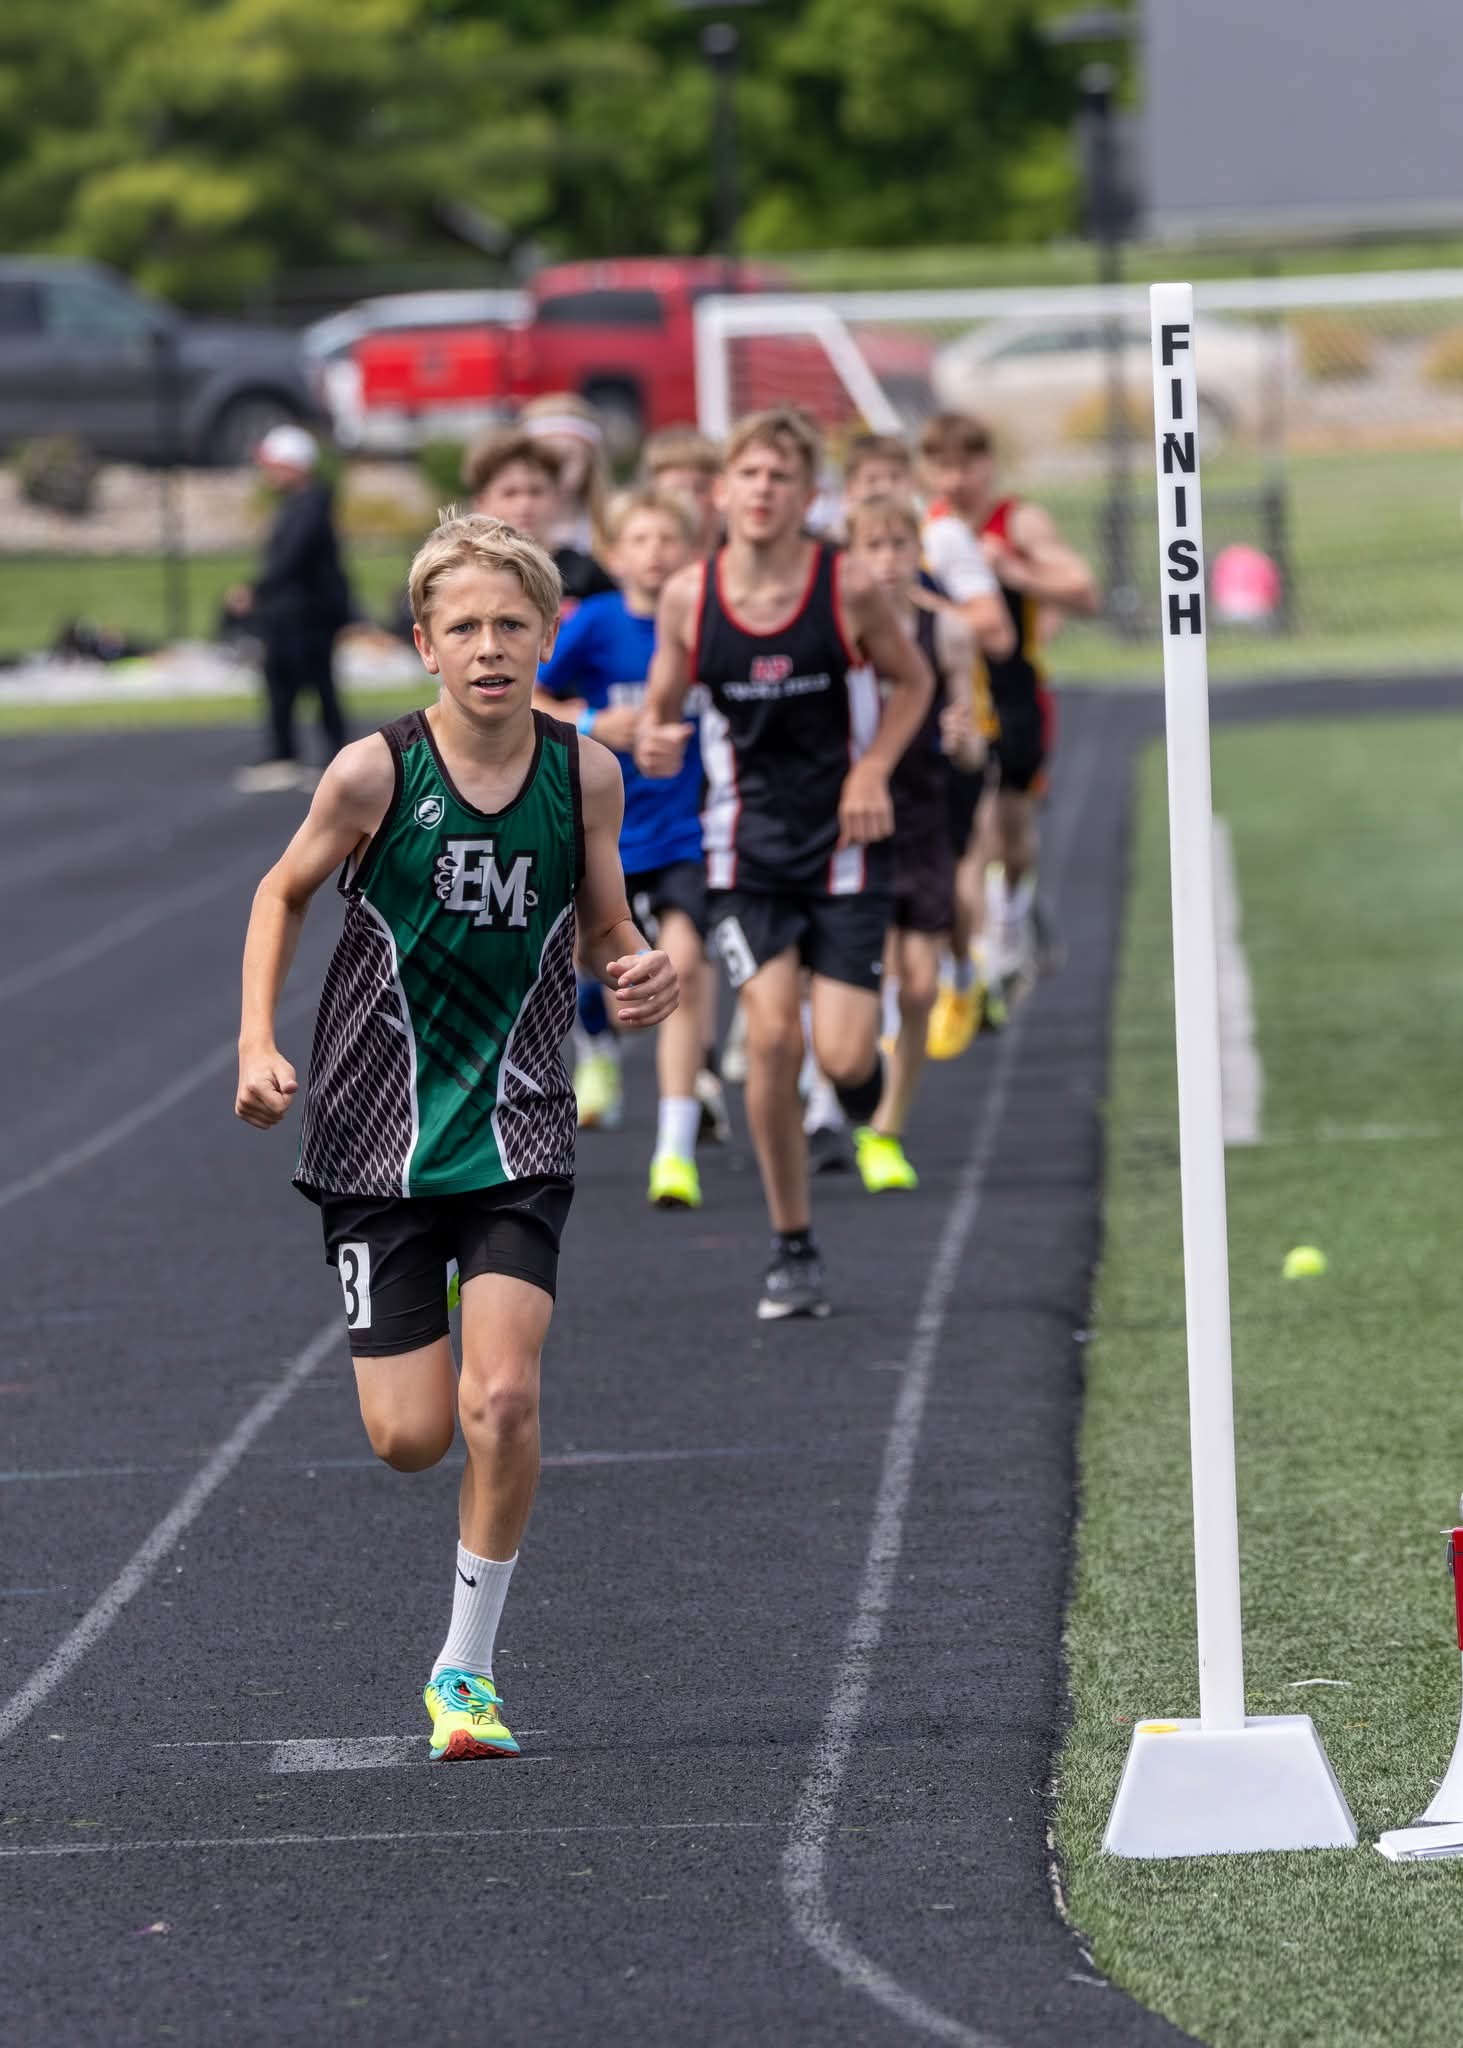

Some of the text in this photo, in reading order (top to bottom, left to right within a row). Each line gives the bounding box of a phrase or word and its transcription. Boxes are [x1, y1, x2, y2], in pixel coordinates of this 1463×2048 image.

[1161, 324, 1202, 635] FINISH
[444, 839, 533, 927] EM
[342, 1248, 360, 1326] 3
